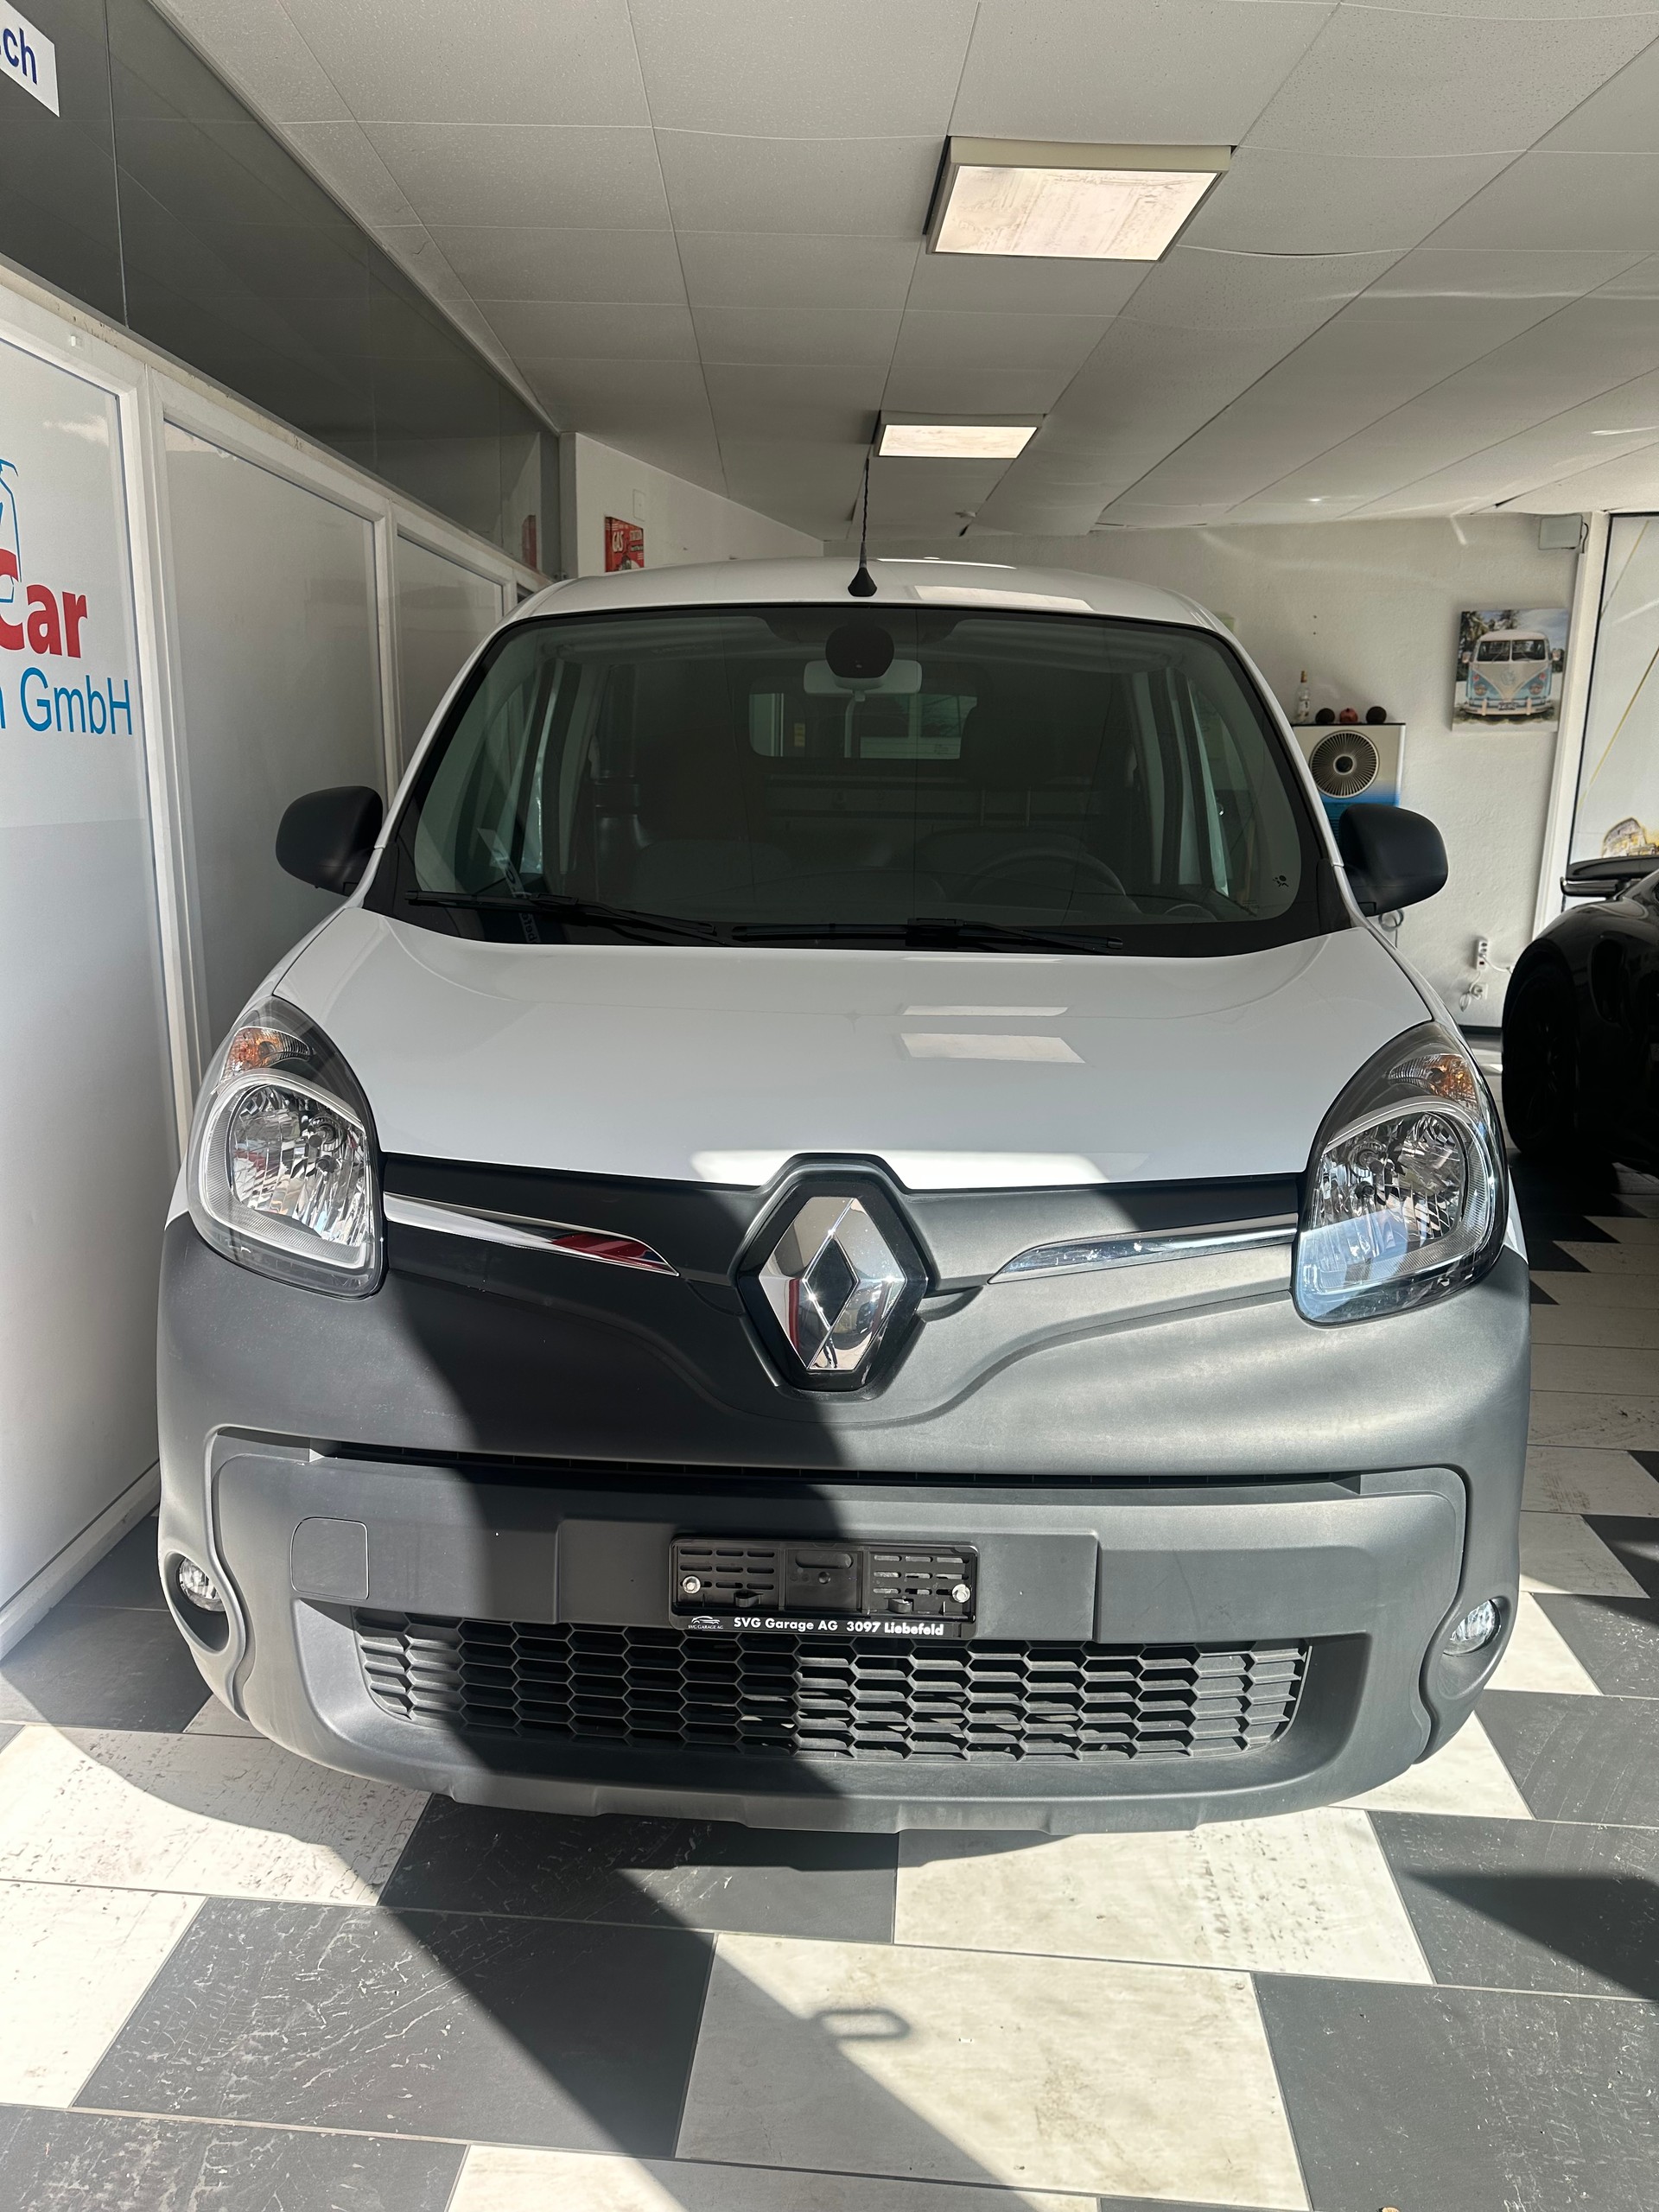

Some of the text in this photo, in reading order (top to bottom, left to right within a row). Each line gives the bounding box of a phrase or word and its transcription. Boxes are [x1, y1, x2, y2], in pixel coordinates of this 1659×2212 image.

[0, 27, 37, 85] ch
[20, 666, 133, 735] GmbH
[734, 1617, 944, 1636] SVG Garage AG 3097 Liebefeld
